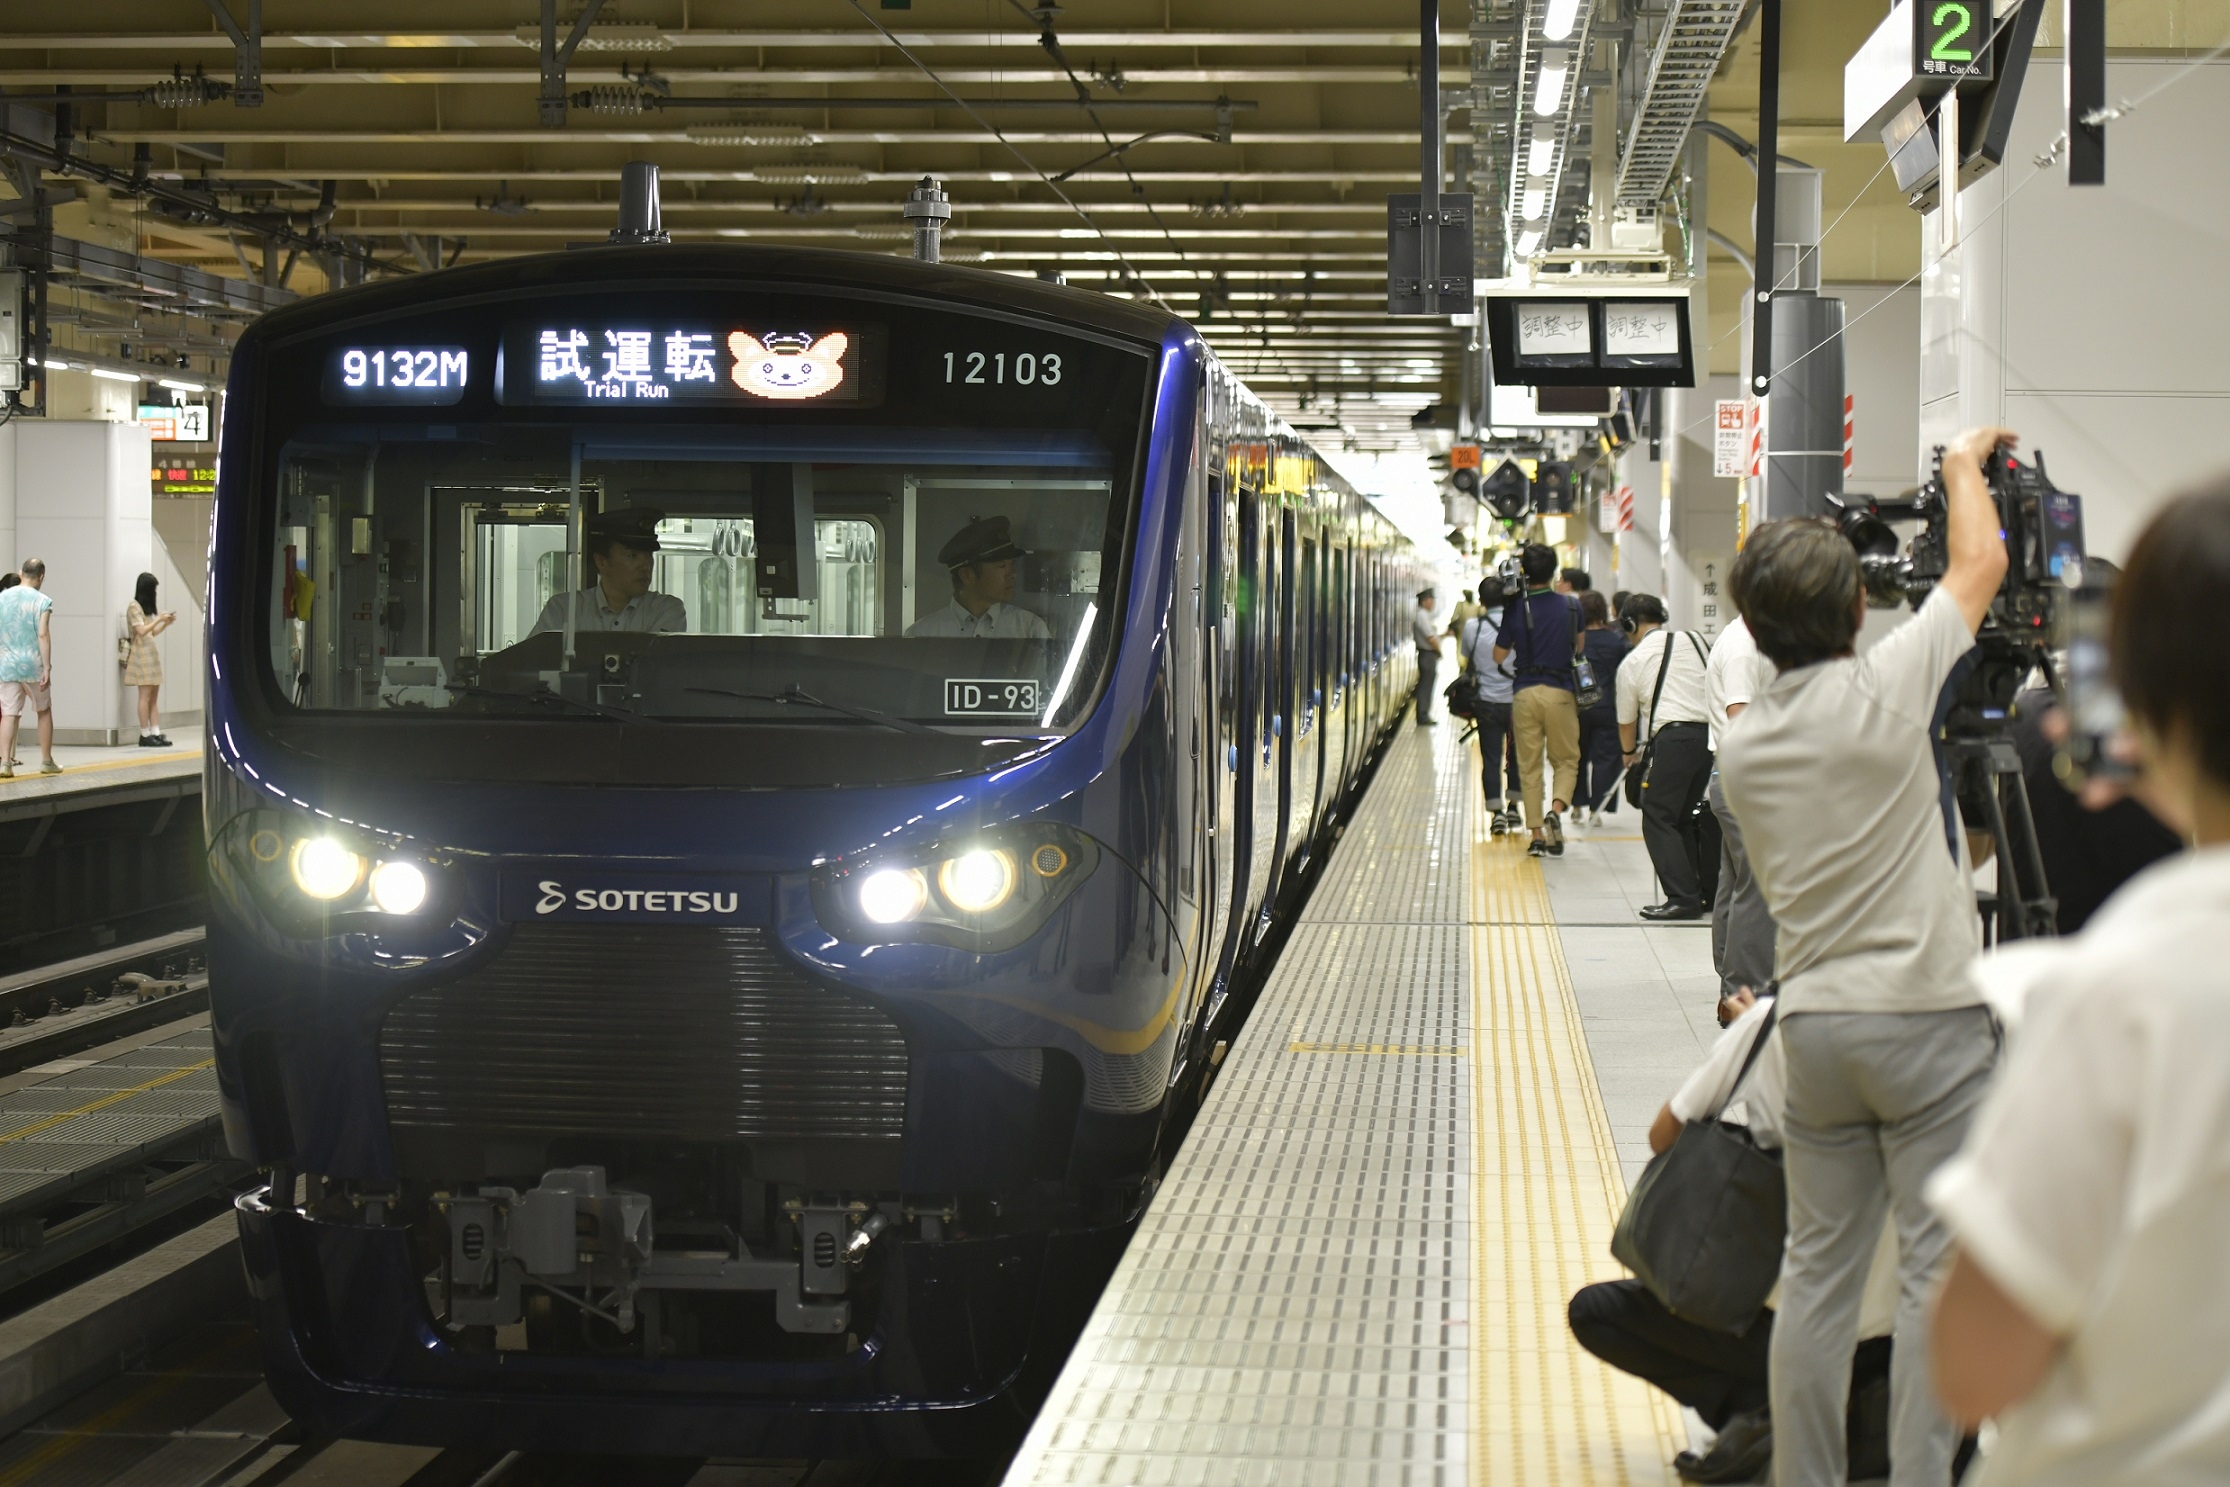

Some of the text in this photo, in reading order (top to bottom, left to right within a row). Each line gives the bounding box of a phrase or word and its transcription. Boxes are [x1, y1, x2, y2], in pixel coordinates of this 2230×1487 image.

[1931, 2, 1972, 60] 2
[1923, 60, 1981, 75] 号車 Car No.
[1522, 314, 1583, 341] 調整中
[1608, 315, 1667, 343] 調整中
[343, 350, 468, 387] 9132M
[540, 328, 716, 383] 試運転
[944, 352, 1062, 385] 12103
[584, 380, 669, 398] Trial Run
[1720, 405, 1743, 413] STOP
[1458, 451, 1475, 464] 20L
[575, 889, 738, 913] SOTETSU
